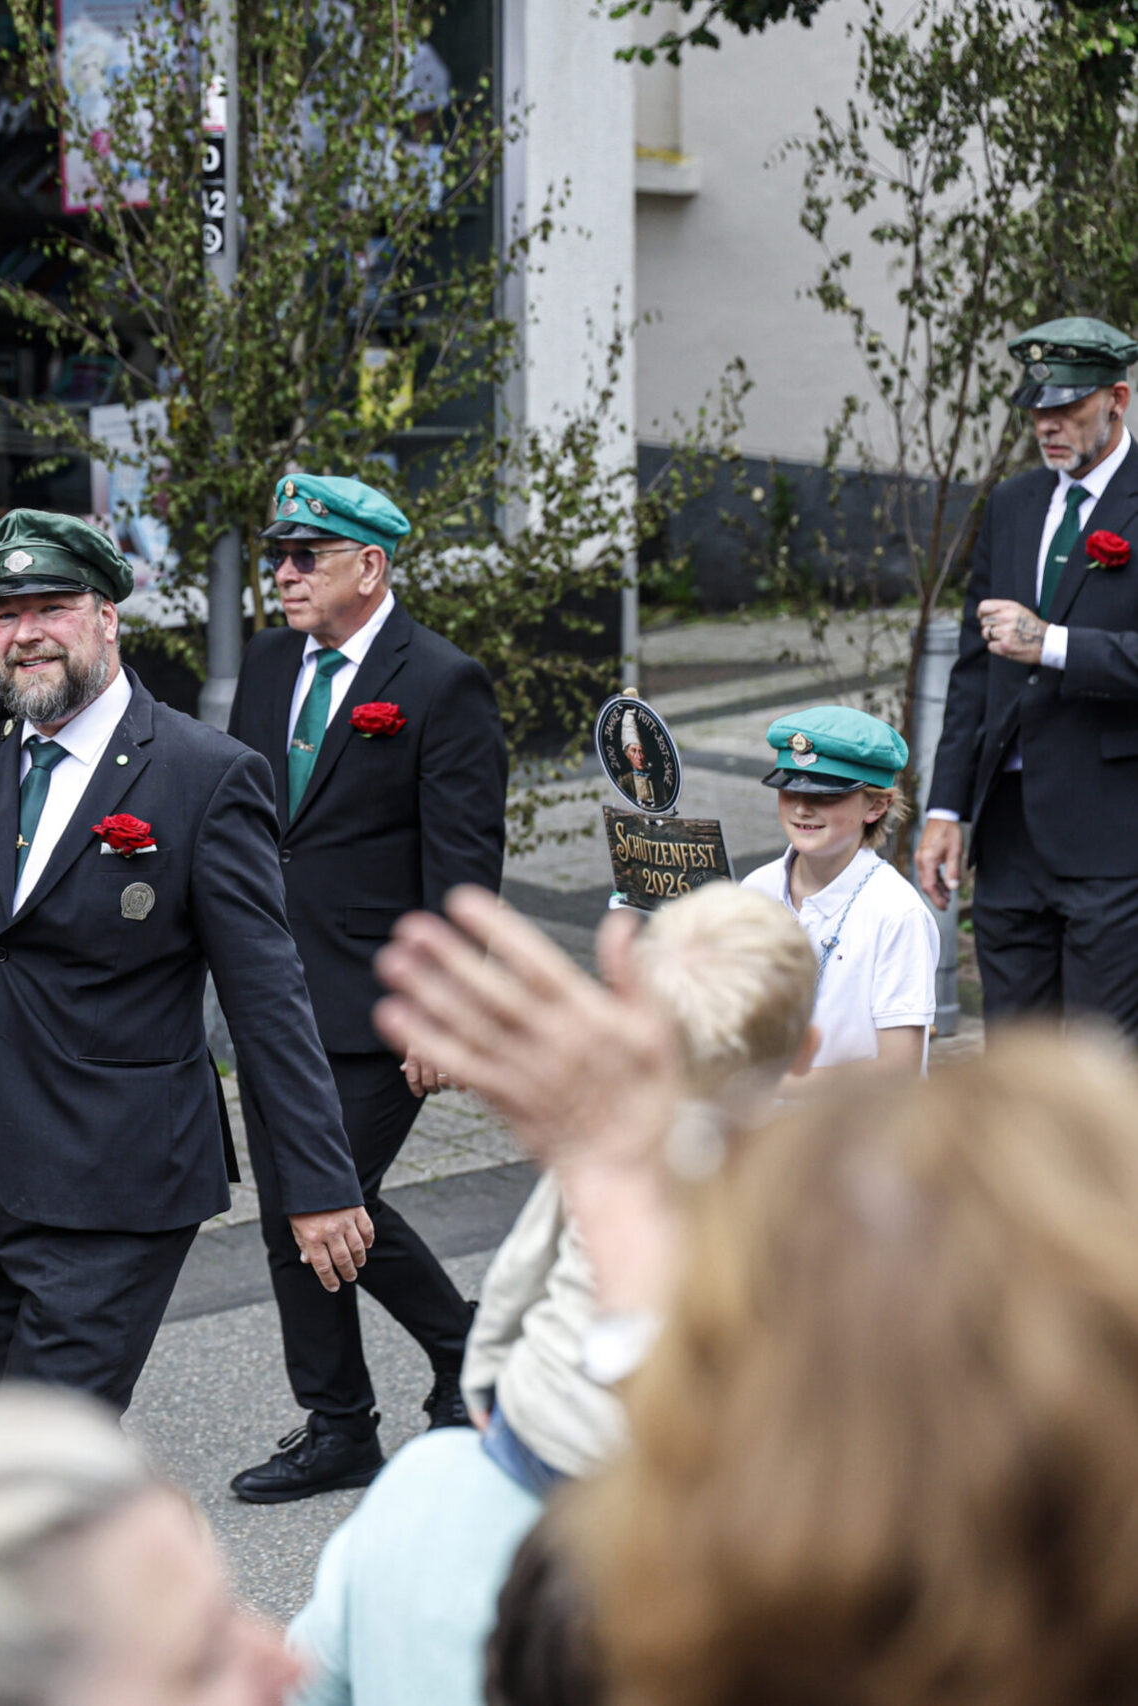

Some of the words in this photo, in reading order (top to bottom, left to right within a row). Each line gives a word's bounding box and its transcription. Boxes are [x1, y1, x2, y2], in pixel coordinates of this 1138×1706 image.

[605, 710, 623, 740] JAHRE
[606, 745, 621, 770] 200
[642, 868, 692, 897] 2026
